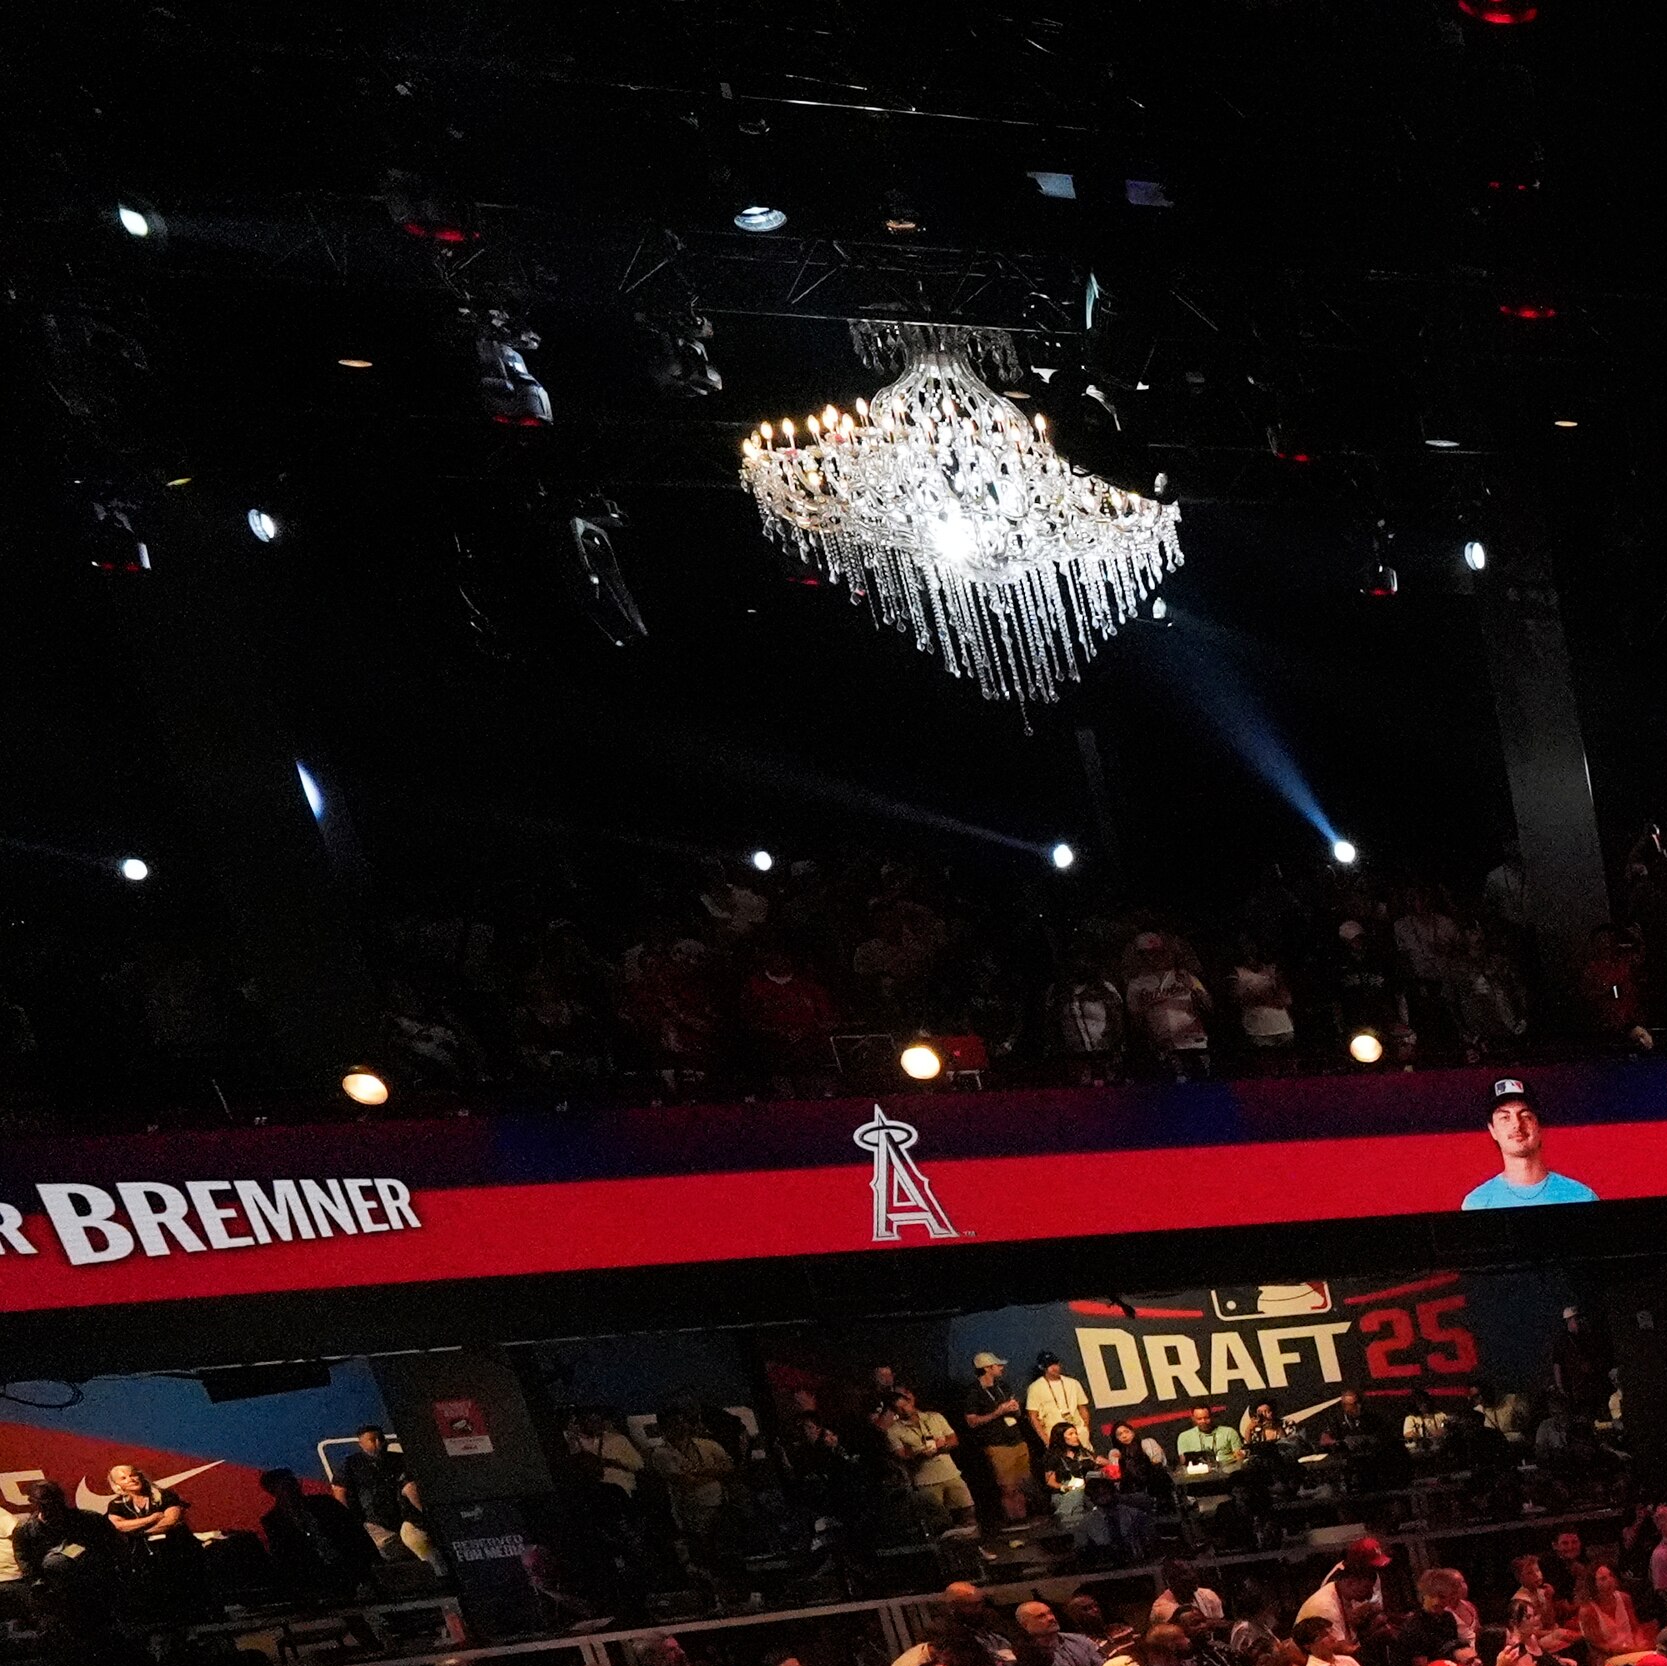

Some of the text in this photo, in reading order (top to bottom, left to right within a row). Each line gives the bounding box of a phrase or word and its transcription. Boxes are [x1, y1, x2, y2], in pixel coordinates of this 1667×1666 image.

[35, 1178, 422, 1266] BREMNER
[1074, 1295, 1478, 1410] DRAFT 25
